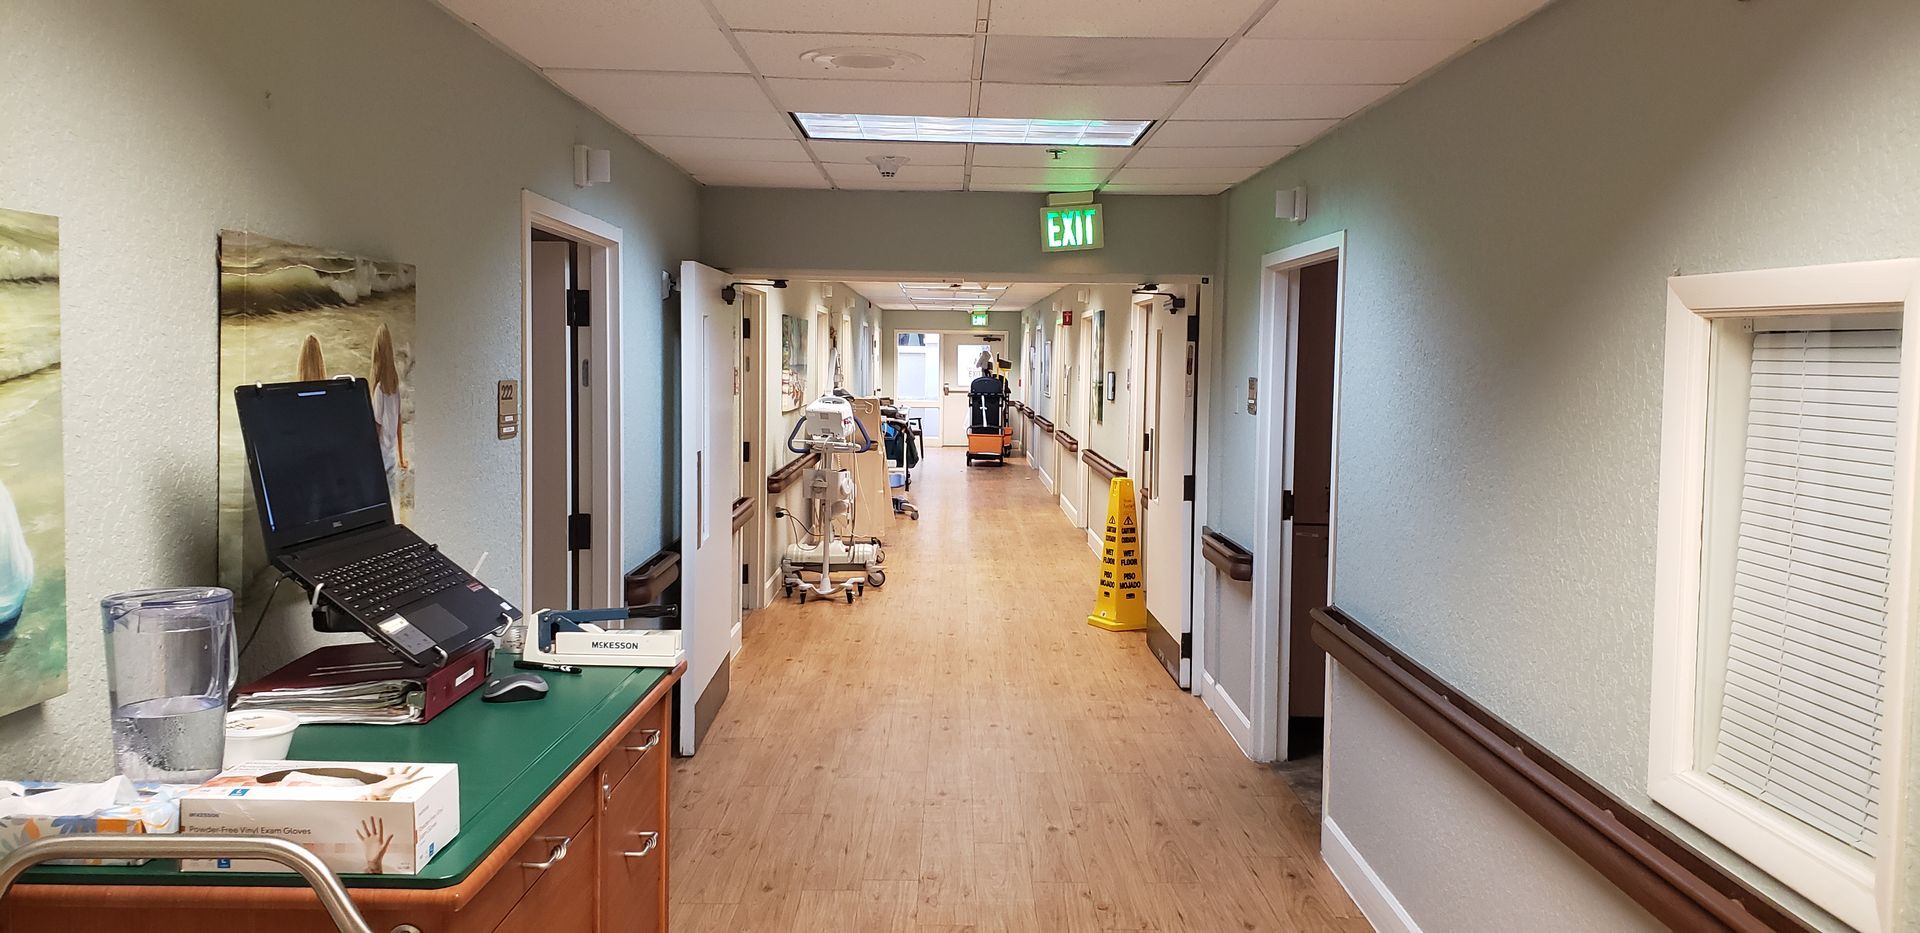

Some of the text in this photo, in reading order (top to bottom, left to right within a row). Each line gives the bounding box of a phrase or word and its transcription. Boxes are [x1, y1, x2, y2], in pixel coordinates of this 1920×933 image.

[1047, 209, 1096, 247] EXIT
[501, 384, 513, 400] 222
[1105, 548, 1114, 556] WET
[1103, 556, 1115, 565] FLOOR
[1121, 558, 1137, 566] FLOOR
[1104, 570, 1112, 579] PISO
[1124, 572, 1135, 580] PISO
[1100, 579, 1115, 588] MOJADO
[1120, 581, 1141, 589] MOJADO
[189, 825, 312, 835] Powder-Free Vinyl Exam Gloves
